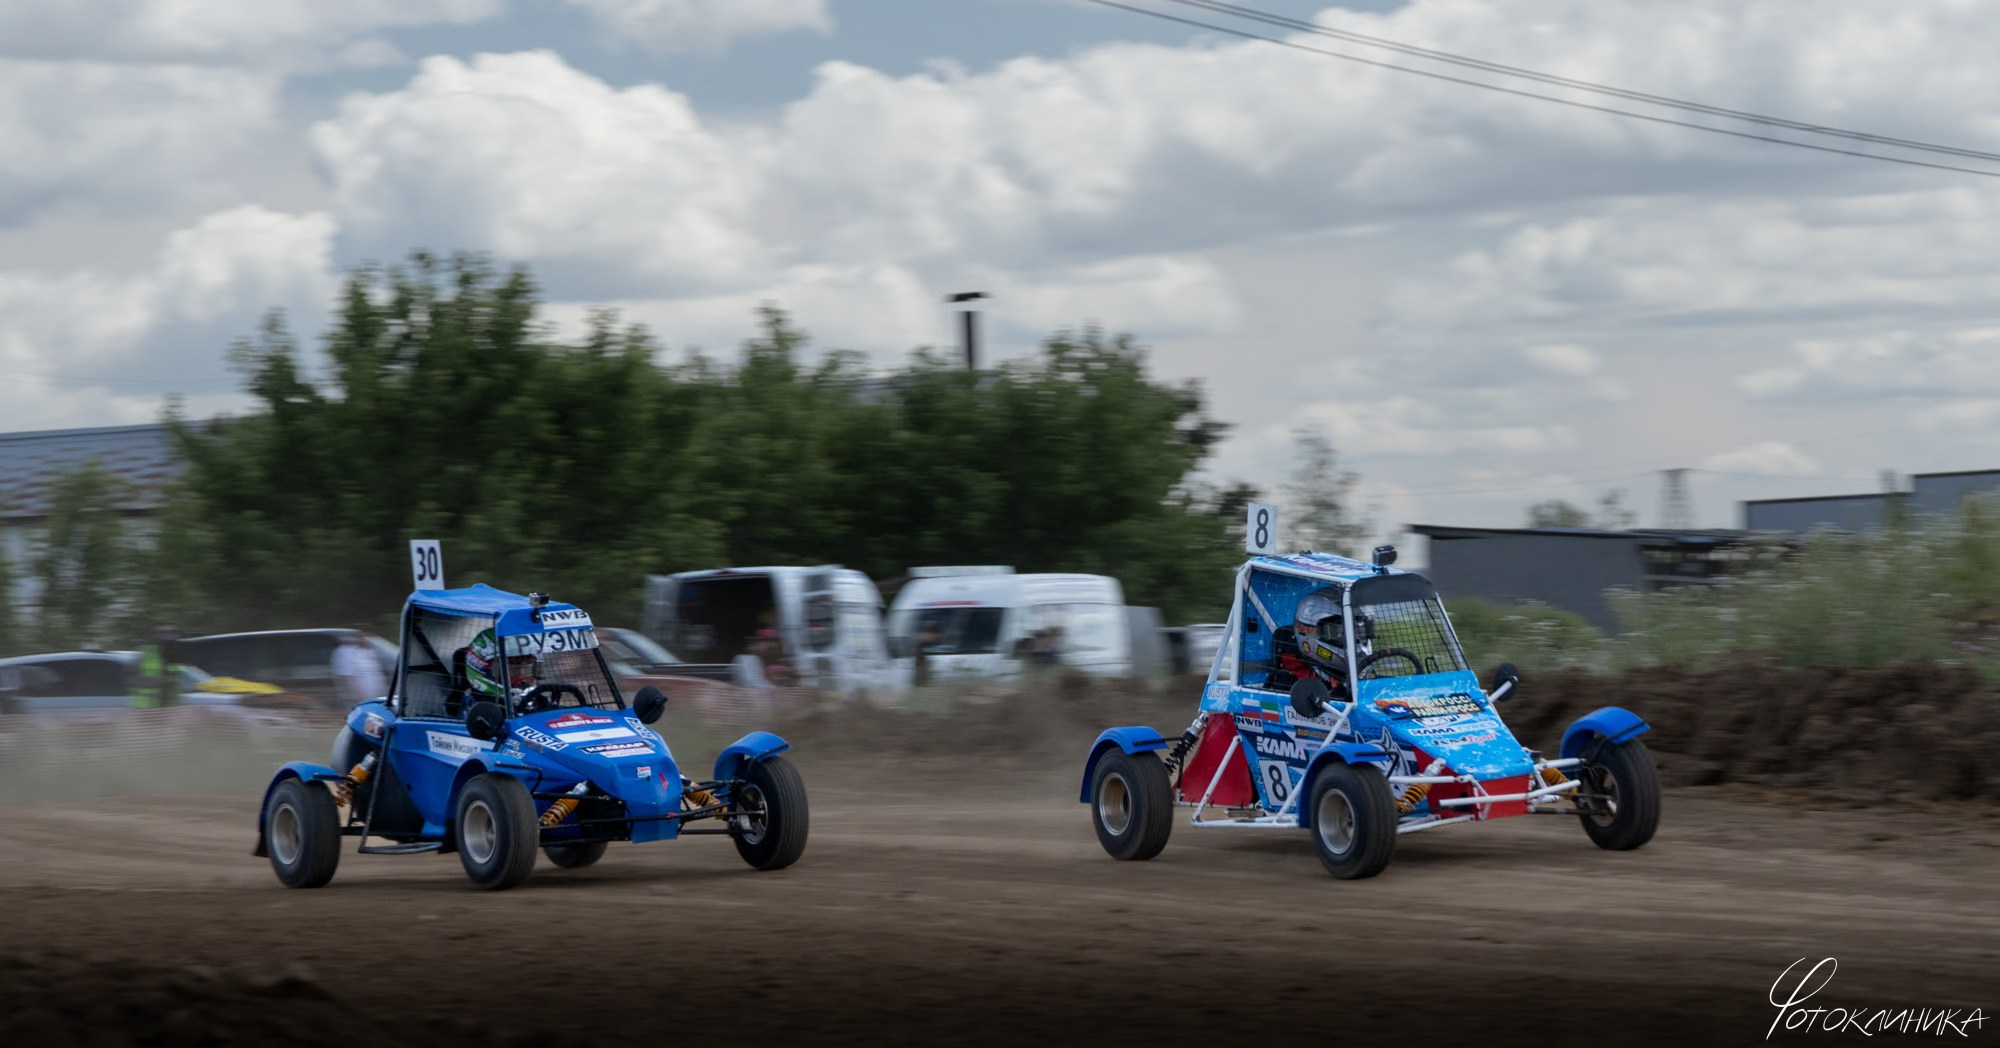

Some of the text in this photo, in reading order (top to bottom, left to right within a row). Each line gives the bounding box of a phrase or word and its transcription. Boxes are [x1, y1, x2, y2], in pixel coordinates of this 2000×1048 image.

[1255, 508, 1269, 549] 8
[416, 546, 439, 581] 30
[541, 610, 588, 622] NWB
[1237, 716, 1263, 728] NWB
[518, 727, 565, 750] RUSTA
[1256, 735, 1307, 760] KAMA
[1268, 764, 1288, 802] 8
